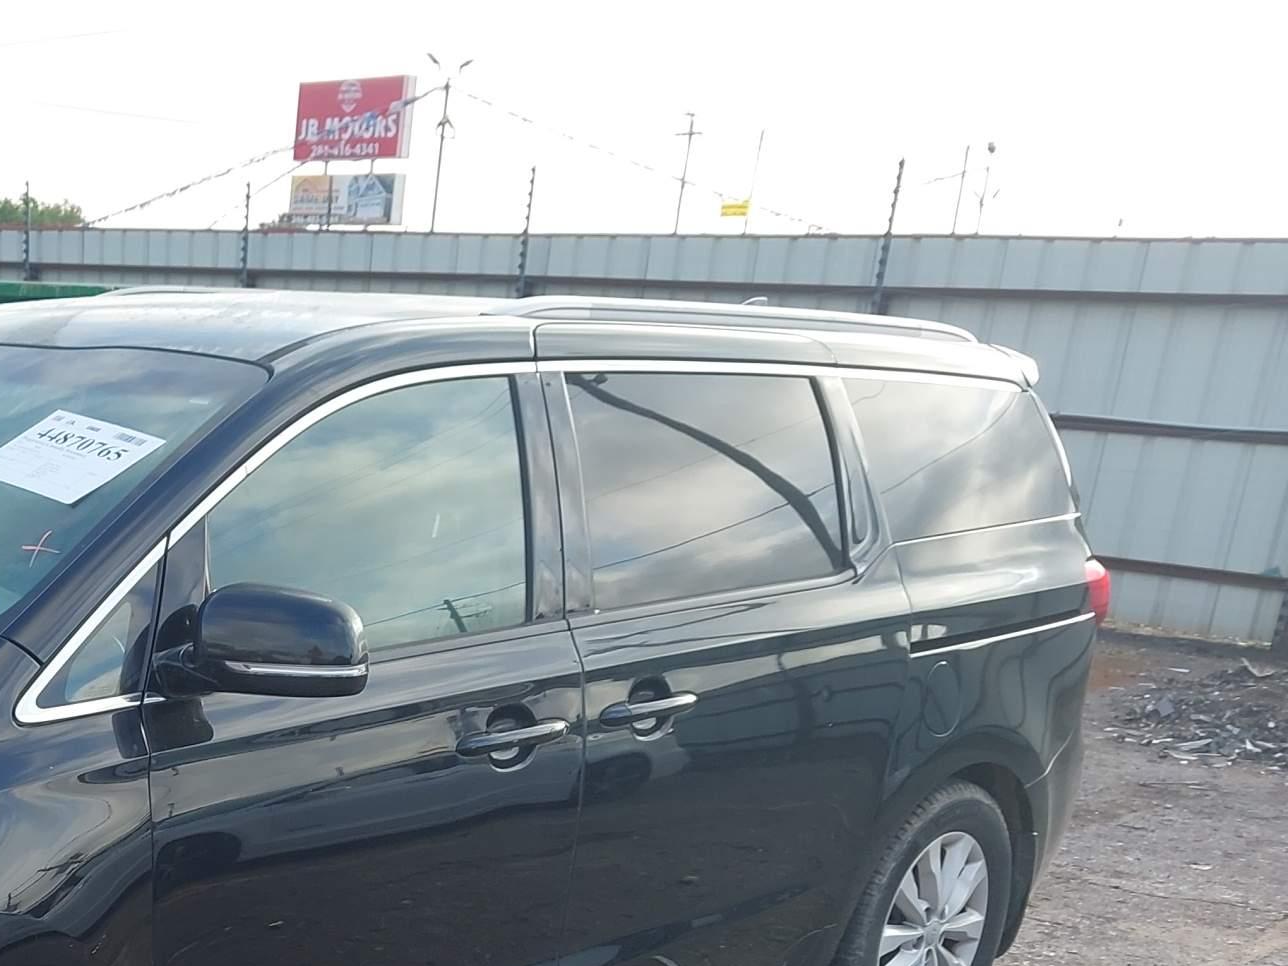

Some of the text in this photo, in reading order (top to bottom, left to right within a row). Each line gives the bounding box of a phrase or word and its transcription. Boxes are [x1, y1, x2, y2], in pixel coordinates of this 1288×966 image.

[297, 113, 398, 141] JB MOTORS
[37, 427, 129, 461] 44870765
